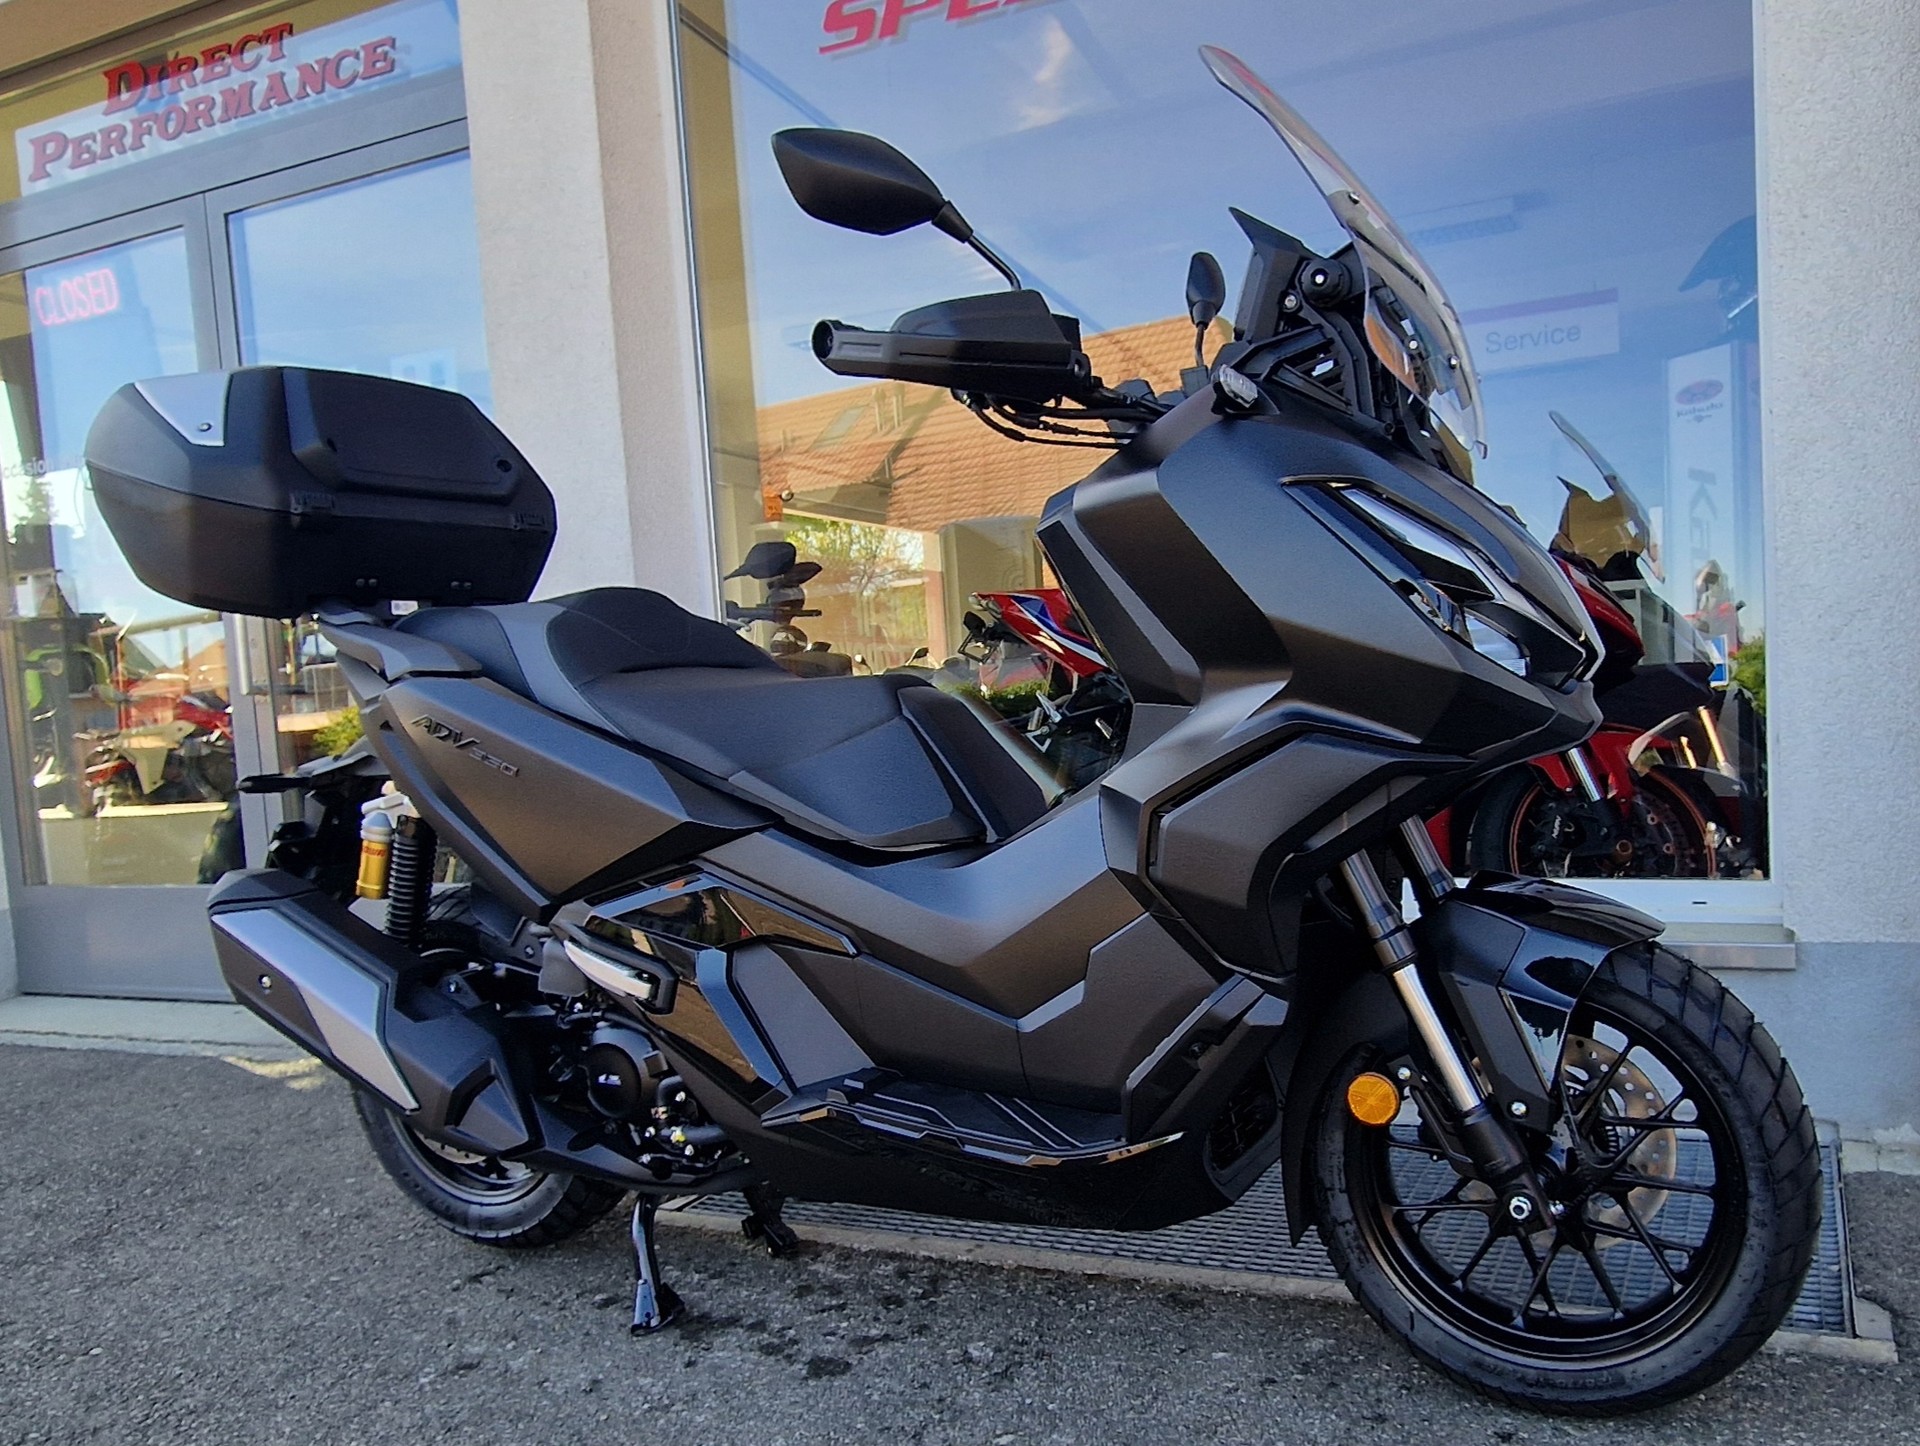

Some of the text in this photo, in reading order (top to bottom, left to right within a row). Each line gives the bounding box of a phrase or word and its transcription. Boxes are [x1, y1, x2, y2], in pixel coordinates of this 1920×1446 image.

[101, 23, 293, 115] DIRECT
[28, 36, 396, 183] PERFORMANCE
[34, 268, 120, 326] CLOSED
[1485, 323, 1582, 353] Service
